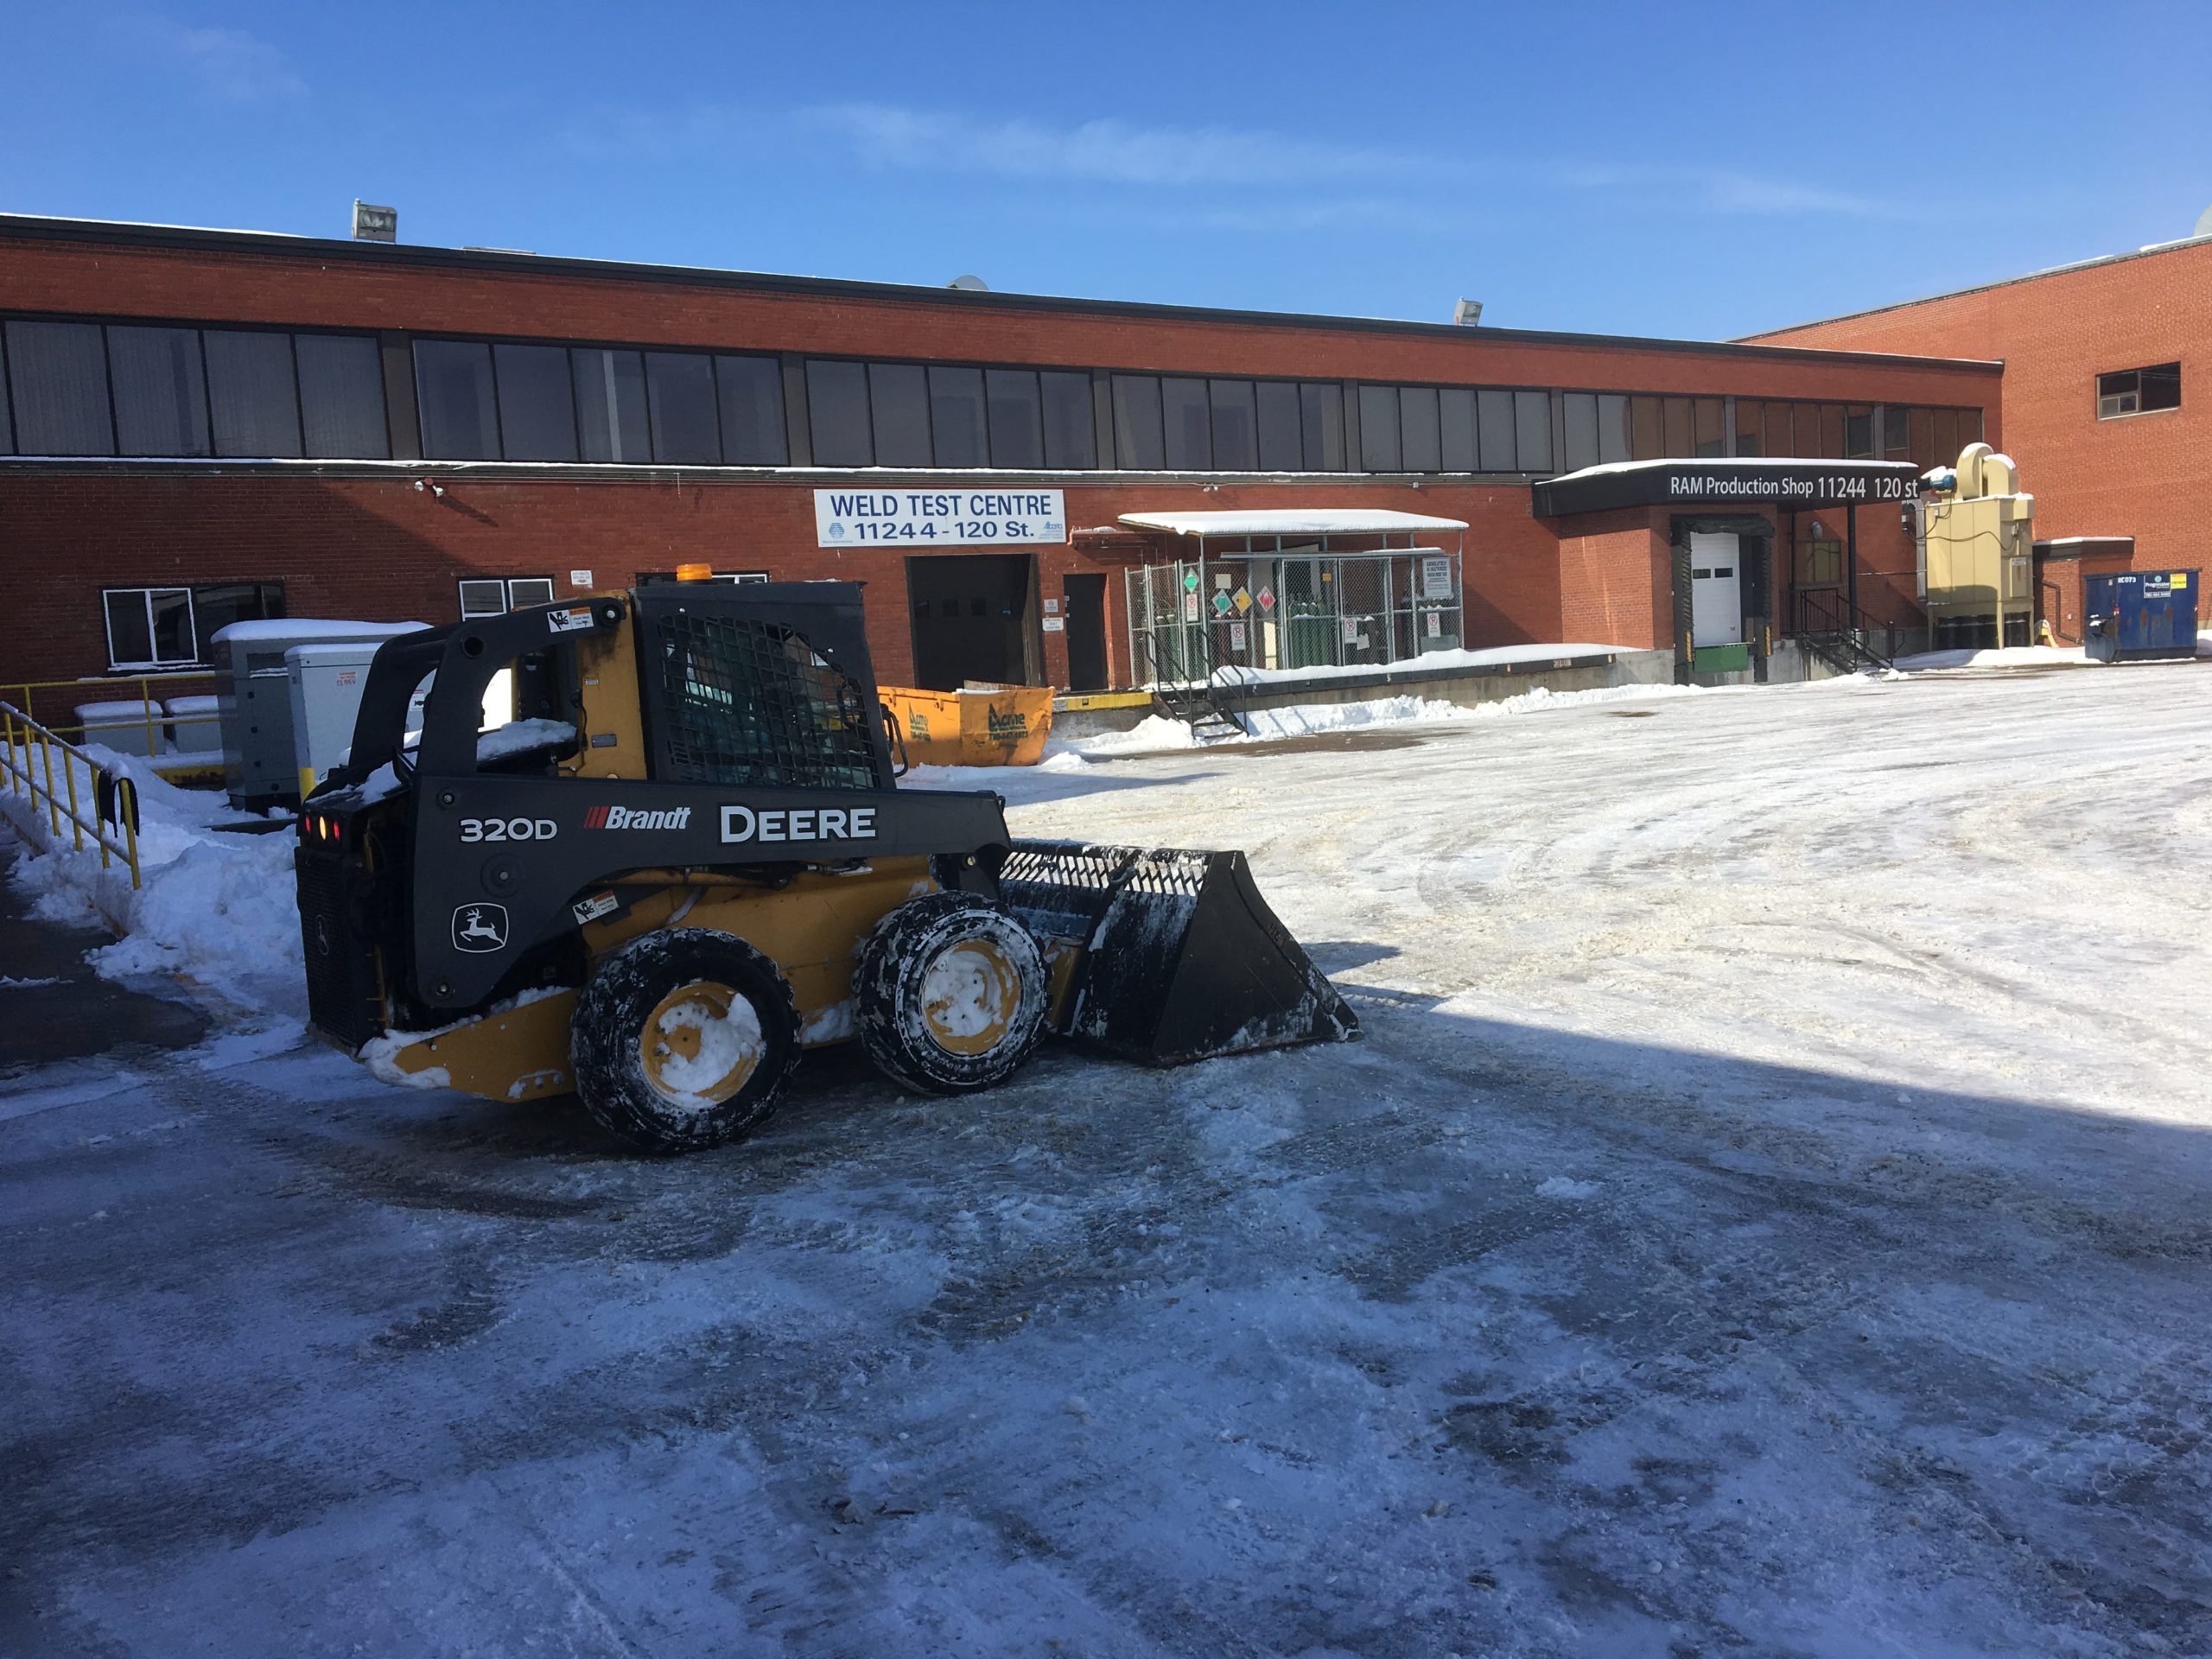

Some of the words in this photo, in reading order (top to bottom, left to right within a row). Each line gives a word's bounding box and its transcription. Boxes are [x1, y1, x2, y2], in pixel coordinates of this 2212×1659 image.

[1671, 477, 1703, 494] RAM
[1707, 477, 1778, 495] Production
[1782, 477, 1814, 498] Shop
[1818, 477, 1866, 499] 11244
[1874, 478, 1901, 499] 120
[1905, 479, 1918, 499] st
[830, 495, 898, 518] WELD
[908, 495, 962, 517] TEST
[970, 495, 1052, 516] CENTRE
[1005, 521, 1034, 537] St.
[988, 702, 1026, 730] Acme
[461, 818, 557, 842] 320D
[605, 806, 691, 830] Brandt
[721, 805, 876, 843] DEERE
